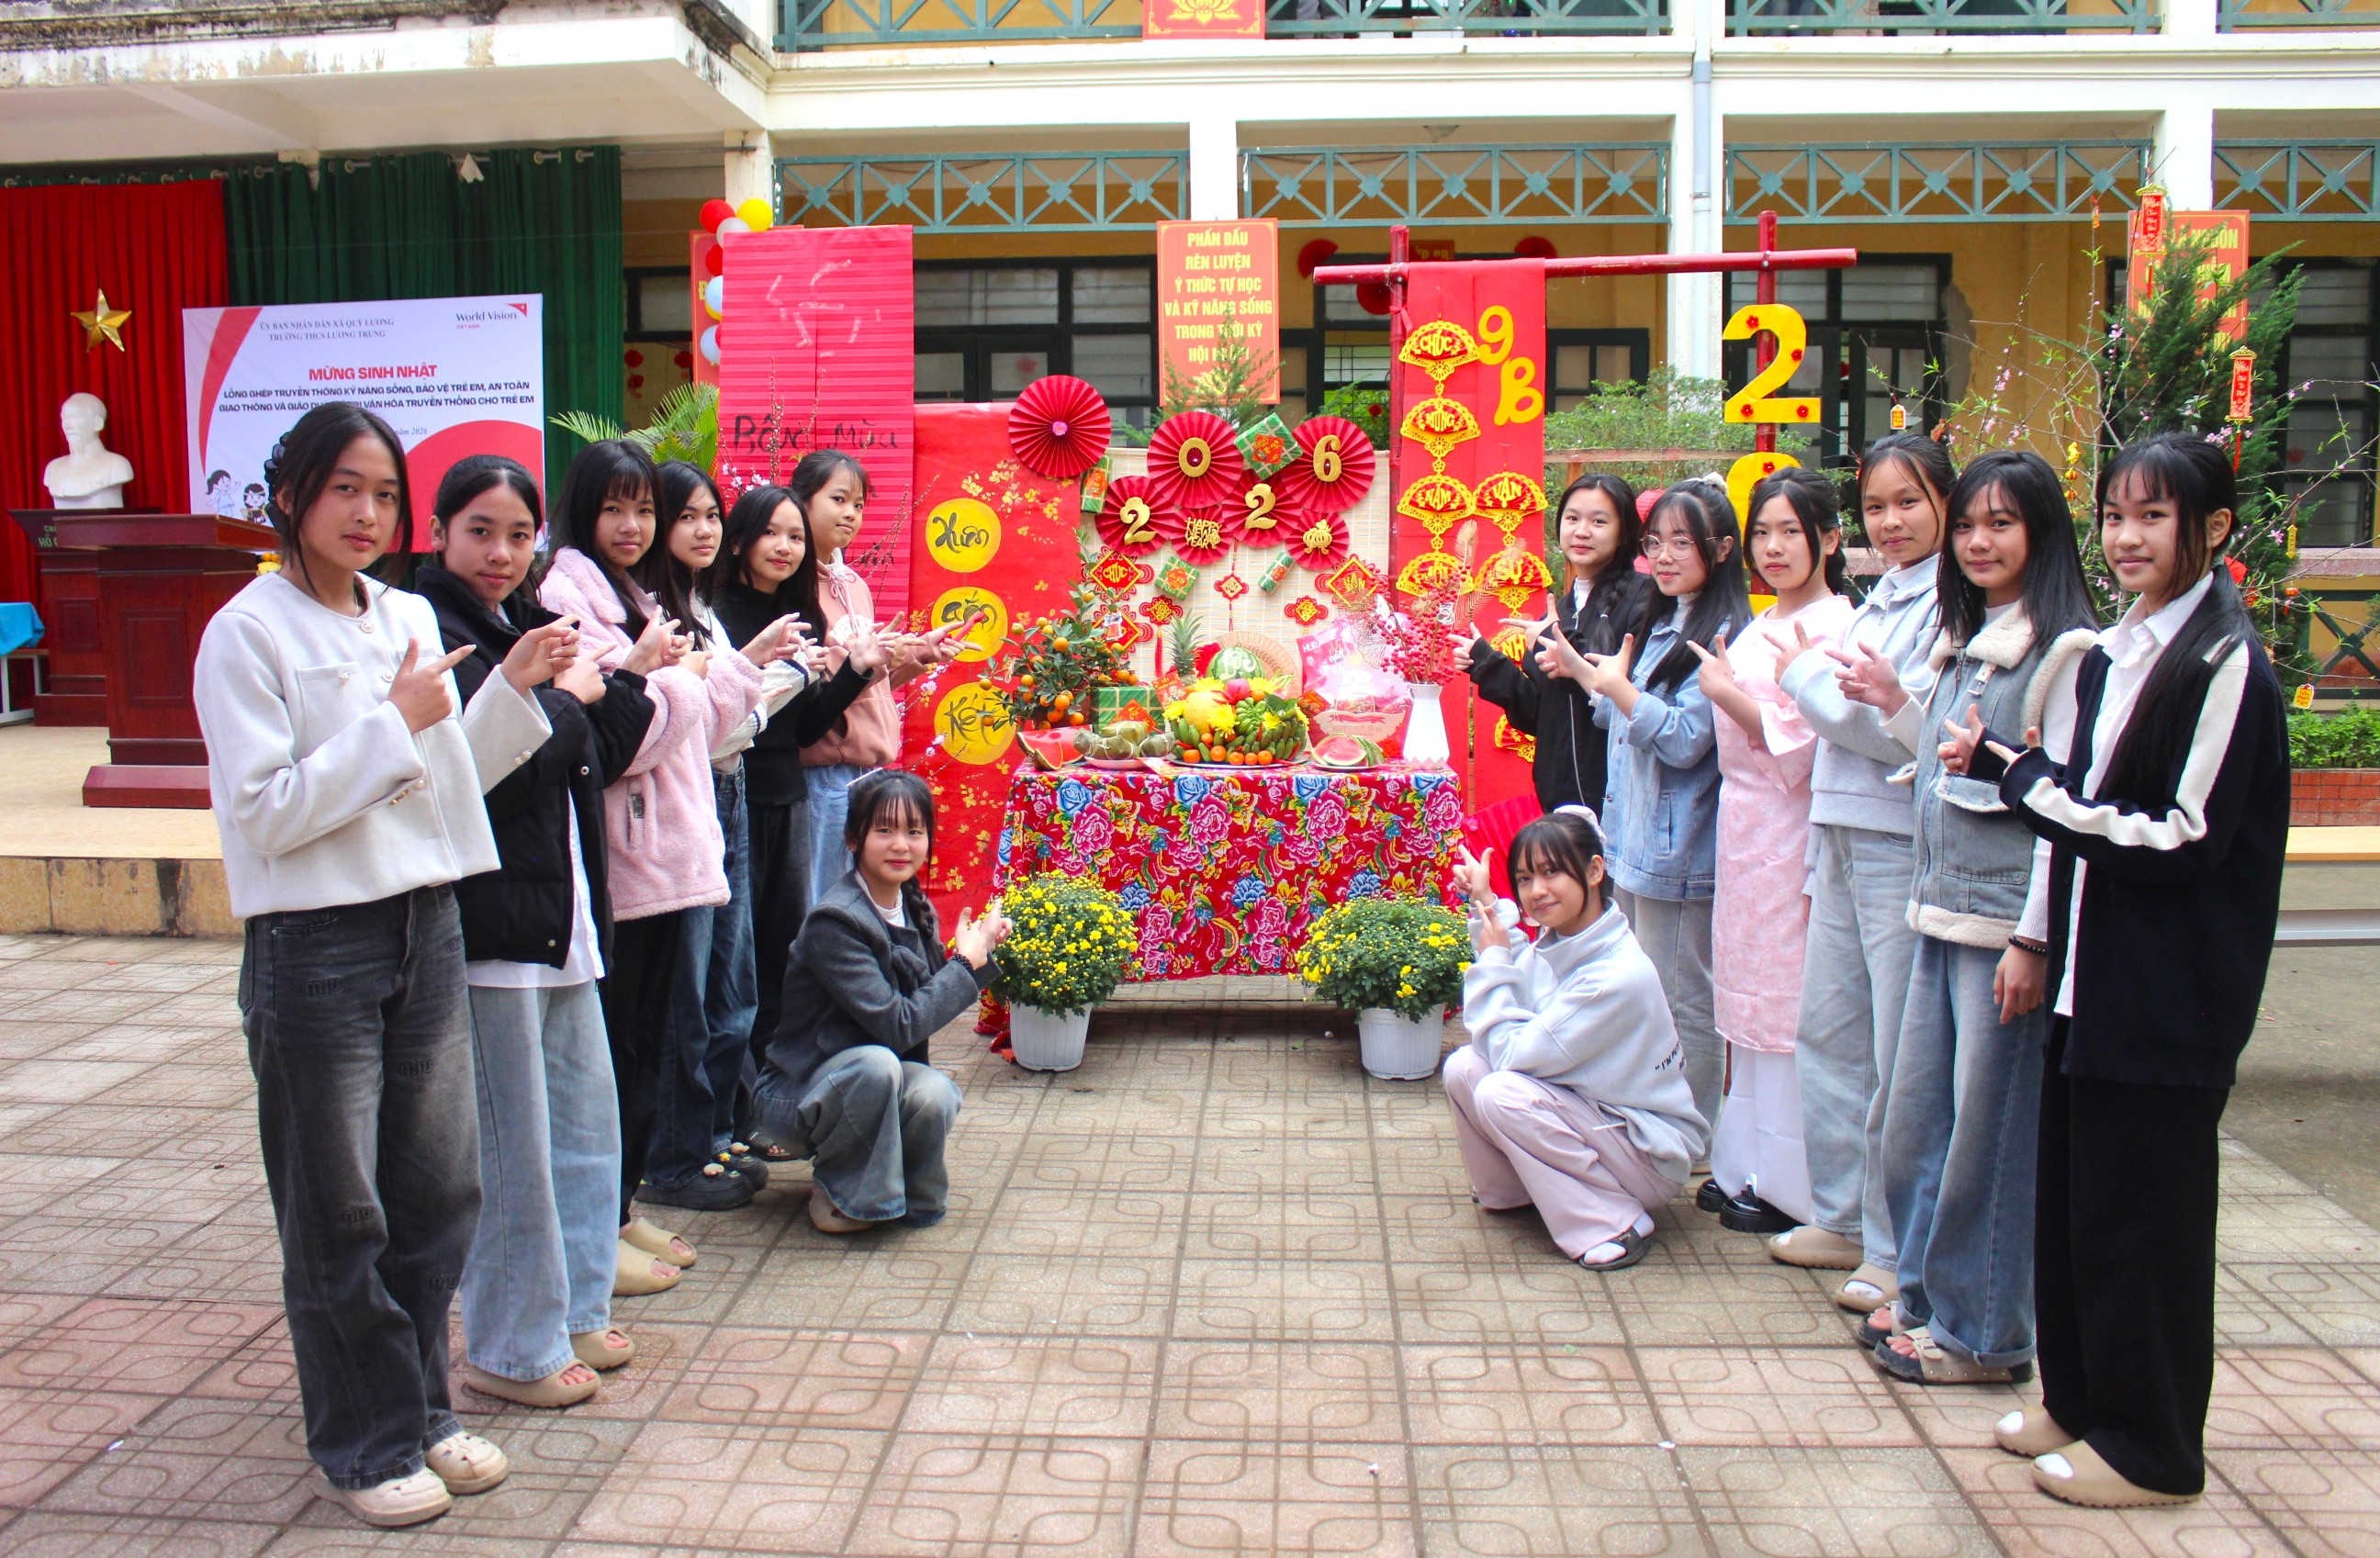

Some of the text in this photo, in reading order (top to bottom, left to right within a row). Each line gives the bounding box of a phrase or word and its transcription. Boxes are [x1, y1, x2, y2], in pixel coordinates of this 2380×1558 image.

[1187, 227, 1248, 247] PHẤN ĐẤU
[1185, 252, 1251, 272] RÈN LUYỆN
[1175, 276, 1262, 295] Ý THỨC TỰ HỌC
[456, 309, 517, 321] World Vision
[1164, 296, 1272, 316] VÀ KỸ NĂNG SỐNG
[273, 321, 288, 330] BAN
[291, 320, 313, 329] NHÂN
[305, 331, 325, 340] THCS
[357, 329, 386, 338] TRUNG
[1175, 325, 1214, 339] TRONG
[1247, 320, 1263, 337] KỲ
[1419, 329, 1454, 355] CHÚC
[1188, 345, 1208, 364] HỘI
[1722, 303, 1821, 423] 2
[309, 362, 437, 380] MỪNG SINH NHẬT
[250, 387, 273, 398] GHÉP
[275, 385, 310, 398] TRUYỀN
[311, 386, 342, 397] THÔNG
[357, 384, 384, 395] NĂNG
[416, 382, 435, 393] BẢO
[436, 381, 449, 393] VỆ
[451, 380, 468, 392] TRẺ
[469, 382, 487, 392] EM,
[488, 382, 502, 390] AN
[504, 379, 530, 390] TOÀN
[219, 403, 241, 412] GIAO
[242, 401, 273, 411] THÔNG
[275, 400, 286, 410] VÀ
[287, 400, 309, 410] GIÁO
[384, 398, 404, 408] HÓA
[406, 395, 443, 407] TRUYỀN
[444, 394, 477, 406] THỐNG
[478, 396, 499, 405] CHO
[500, 393, 518, 404] TRẺ
[520, 395, 534, 403] EM
[1424, 402, 1455, 434] MỪNG
[410, 427, 428, 435] 2026
[932, 510, 990, 555] Xuân
[1184, 516, 1223, 532] HAPPY
[1185, 535, 1209, 549] YEAR
